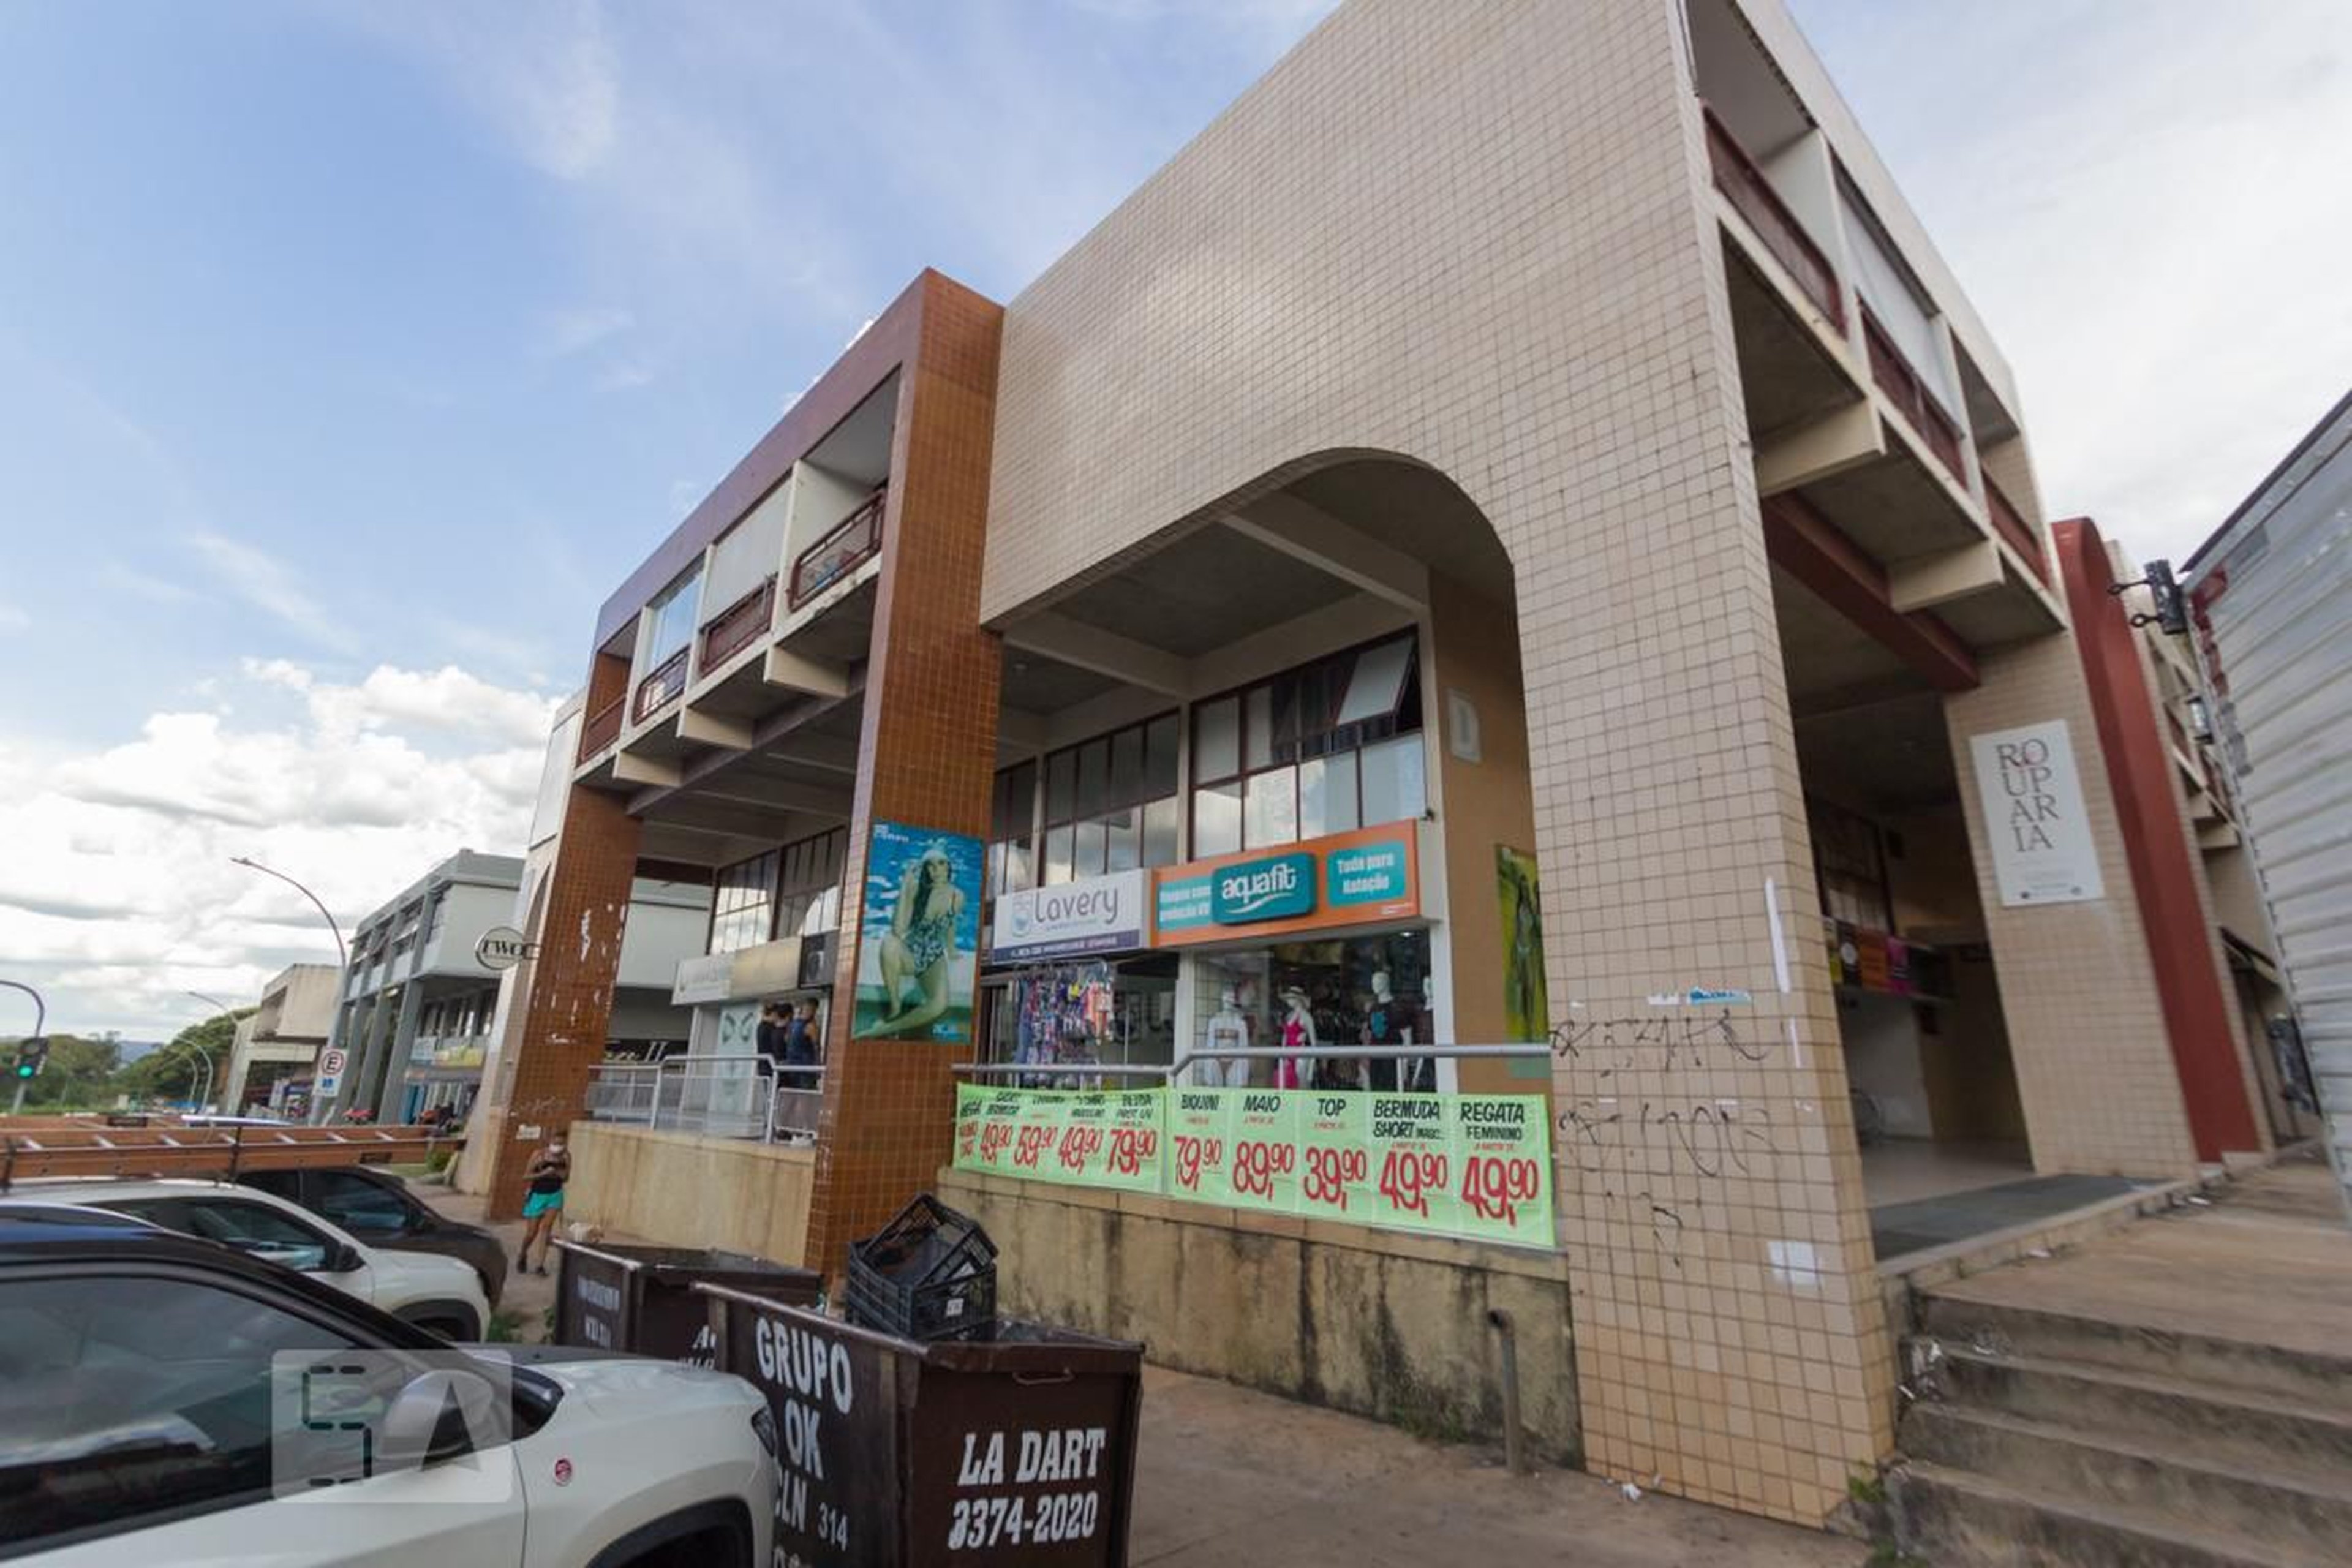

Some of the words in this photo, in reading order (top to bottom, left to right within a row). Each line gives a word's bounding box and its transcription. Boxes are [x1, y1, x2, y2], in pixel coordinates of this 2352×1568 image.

[1221, 862, 1297, 904] aquafit
[327, 1055, 339, 1072] E
[1180, 1093, 1221, 1112] BIQUINI
[1243, 1095, 1281, 1113] MAIO
[1316, 1098, 1347, 1117] TOP
[1373, 1099, 1440, 1121] BERMUDA
[1460, 1102, 1525, 1124] REGATA
[1373, 1121, 1414, 1139] SHORT
[1466, 1125, 1523, 1141] FEMININO
[1233, 1140, 1295, 1202] 89,90
[1303, 1146, 1368, 1212] 39,90
[1379, 1151, 1448, 1218] 49,90
[1461, 1156, 1539, 1227] 49,90
[756, 1316, 853, 1415] GRUPO
[784, 1397, 824, 1482] OK
[957, 1431, 1005, 1487] LA
[1015, 1427, 1106, 1483] DART
[818, 1501, 848, 1552] 314
[947, 1490, 1099, 1550] 3374-2020
